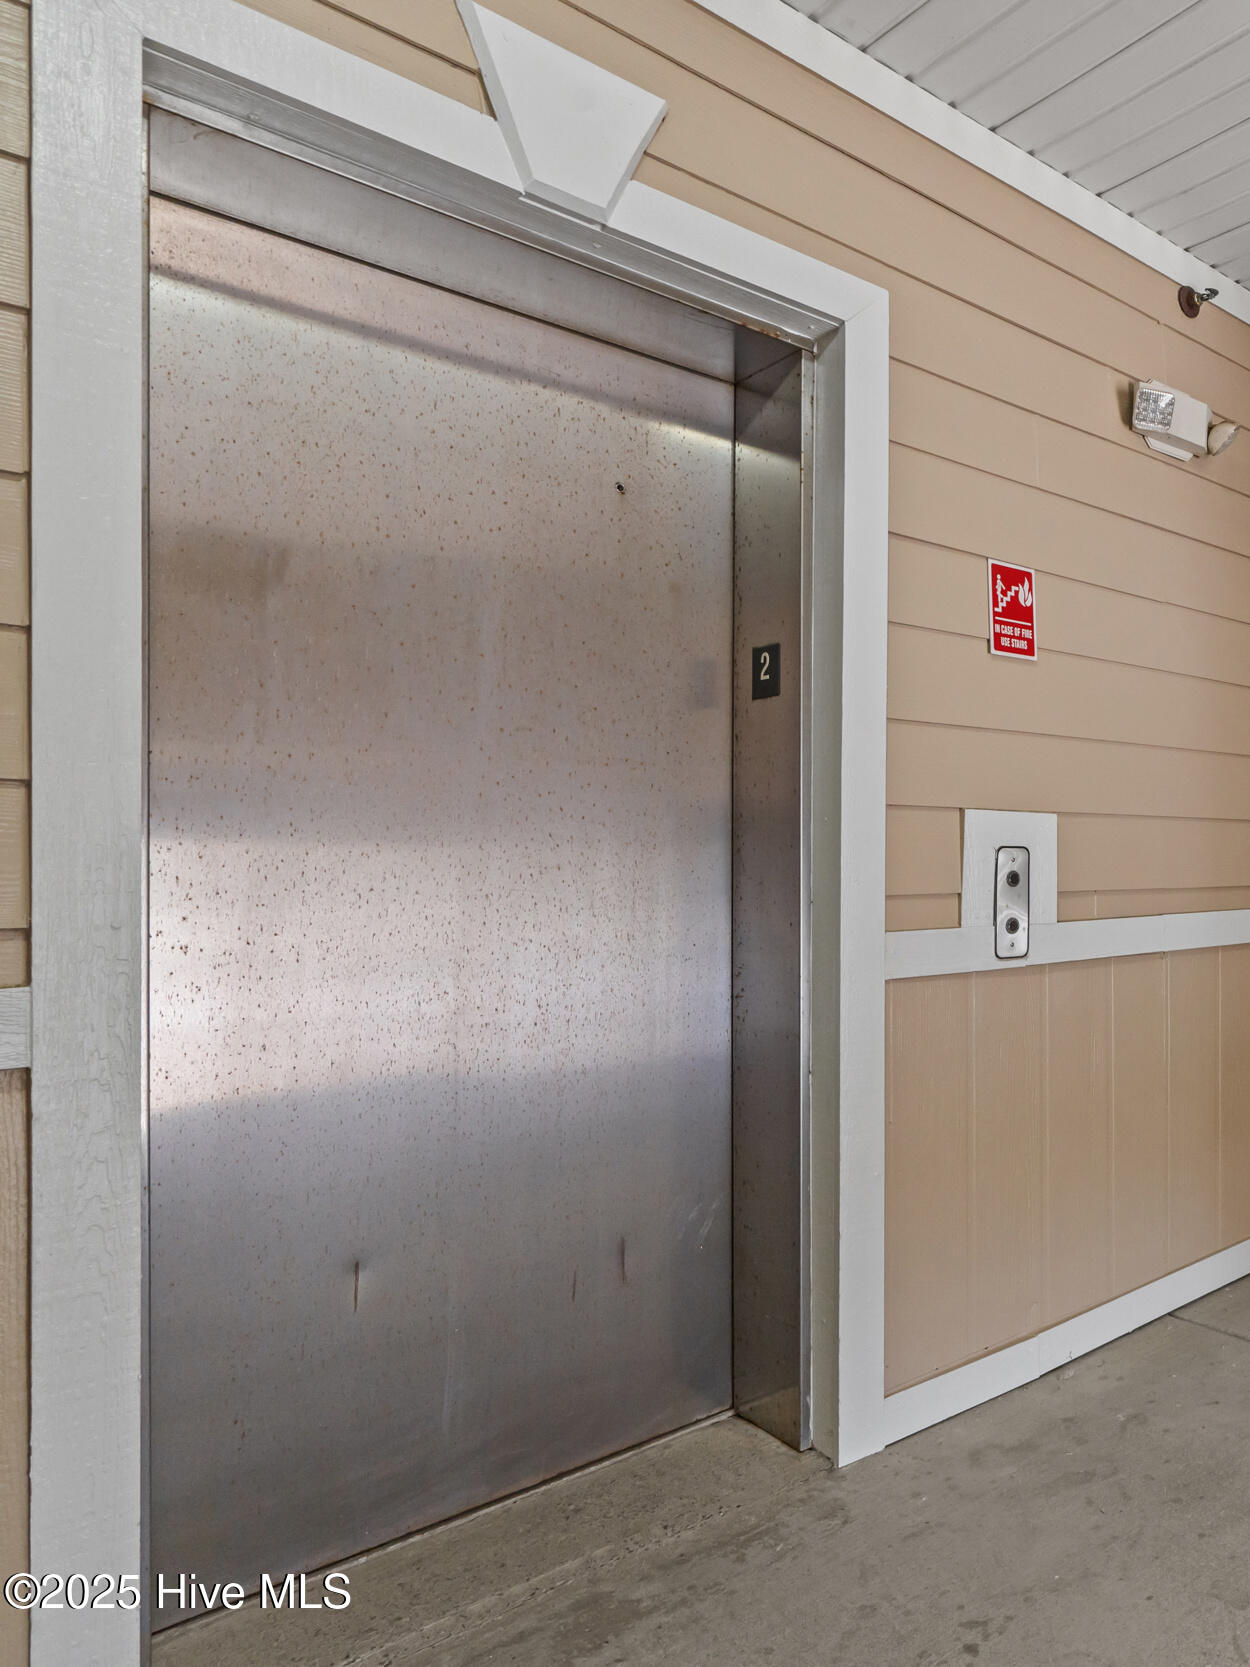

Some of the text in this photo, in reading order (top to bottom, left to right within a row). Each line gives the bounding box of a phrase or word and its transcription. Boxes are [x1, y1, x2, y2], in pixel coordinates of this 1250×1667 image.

[995, 624, 1032, 639] IN CASE OF FIRE
[1000, 637, 1028, 650] USE STAIRS
[760, 652, 770, 680] 2
